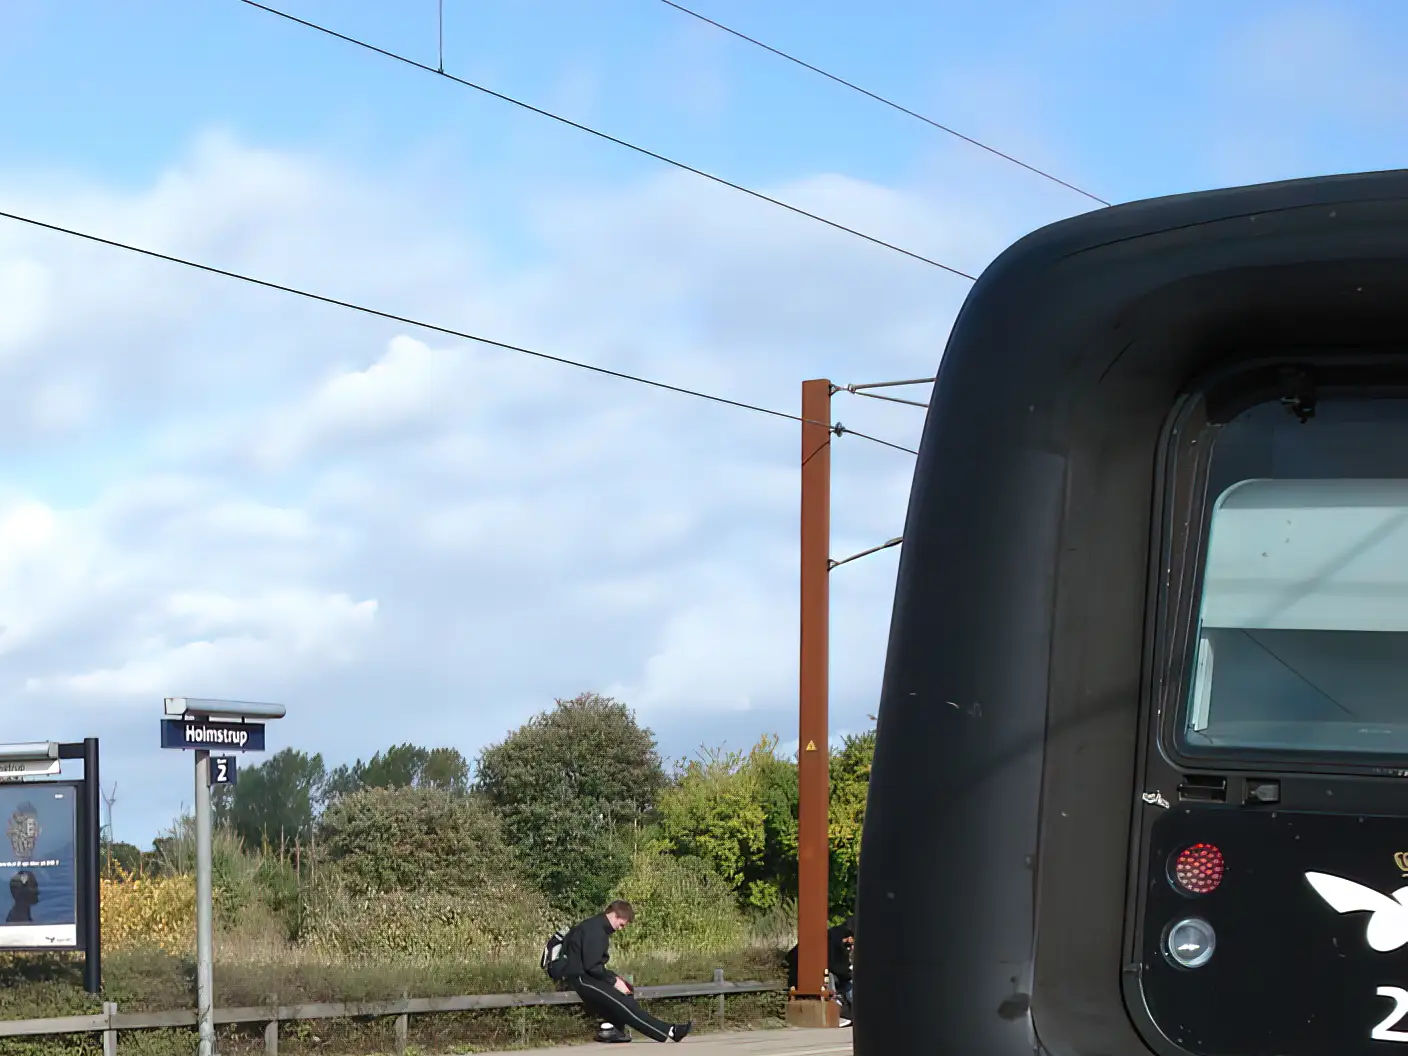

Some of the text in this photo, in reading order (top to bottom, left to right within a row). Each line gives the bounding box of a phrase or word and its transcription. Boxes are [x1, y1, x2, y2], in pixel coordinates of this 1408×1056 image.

[185, 724, 248, 747] Holmstrup
[217, 764, 228, 782] 2
[1371, 985, 1408, 1042] 2
